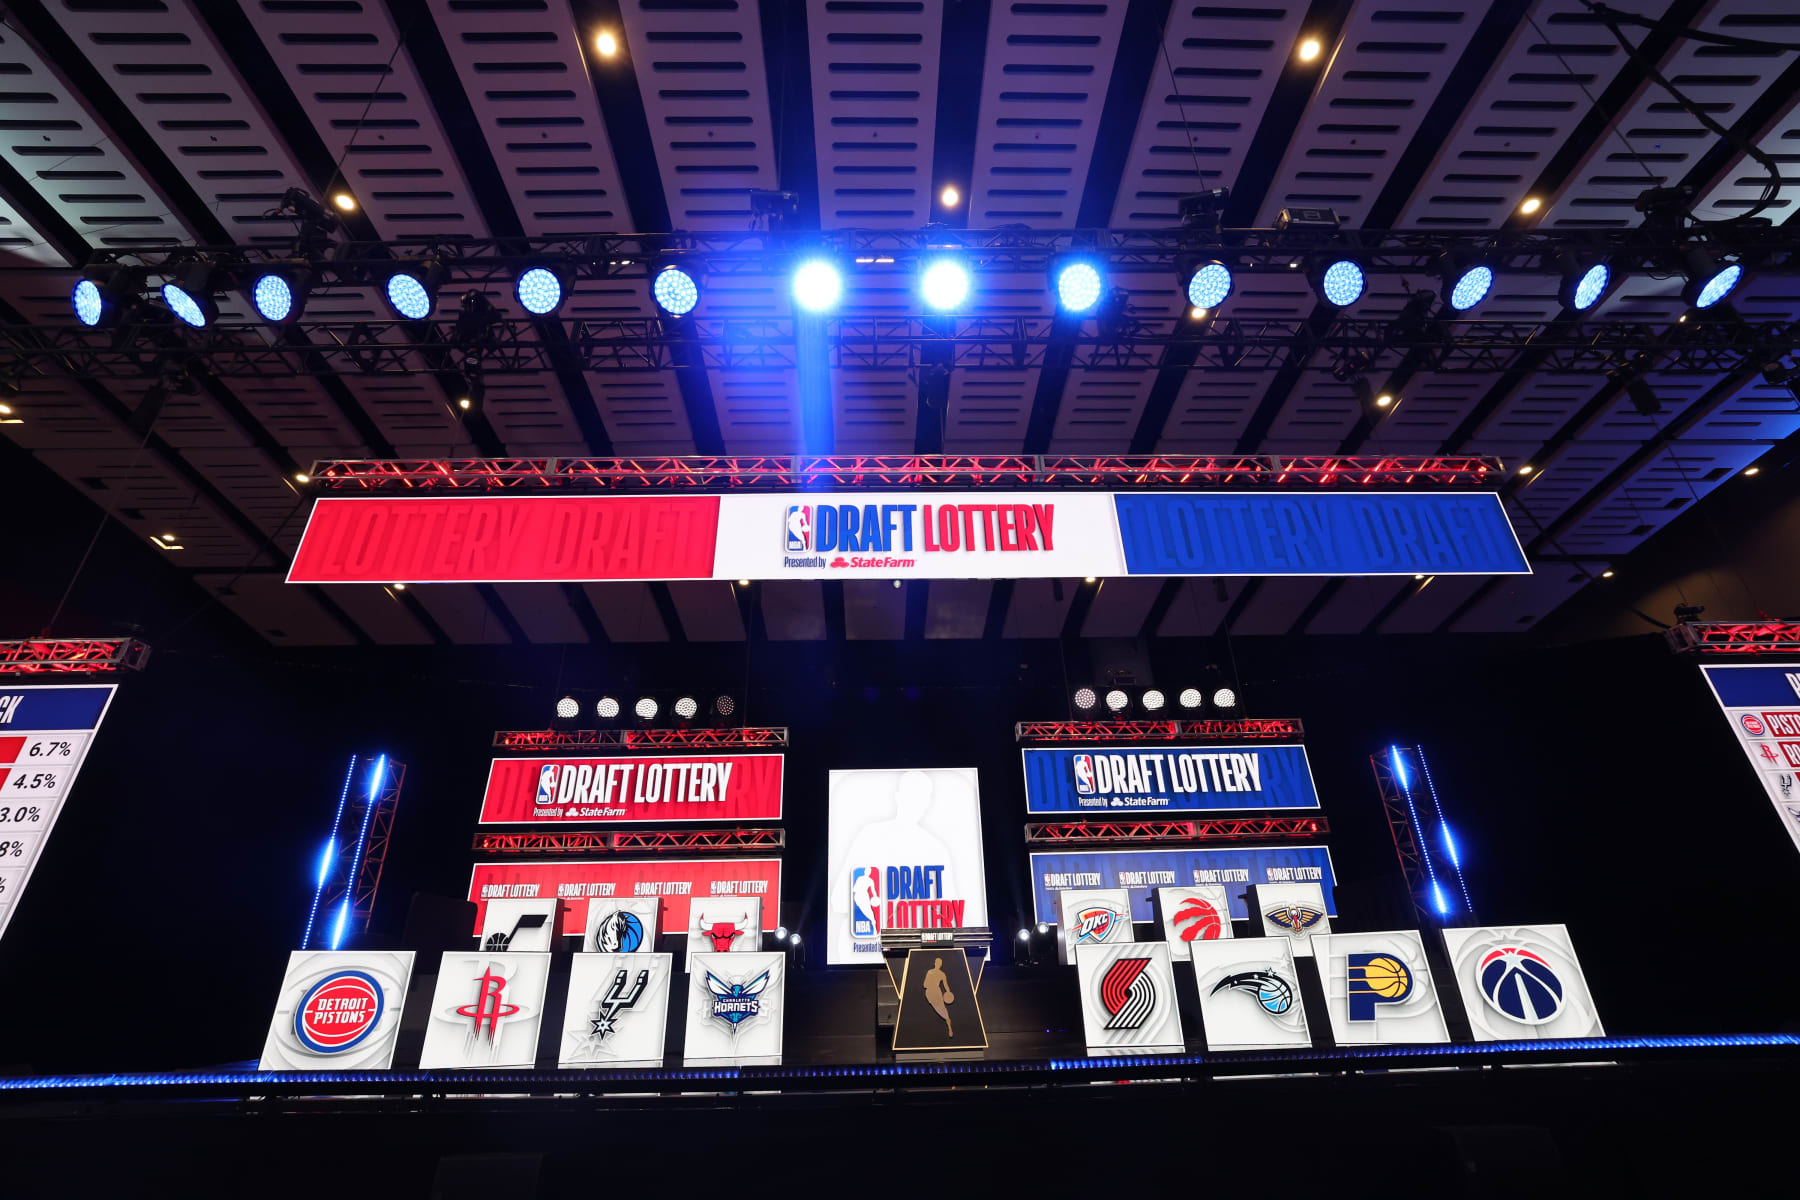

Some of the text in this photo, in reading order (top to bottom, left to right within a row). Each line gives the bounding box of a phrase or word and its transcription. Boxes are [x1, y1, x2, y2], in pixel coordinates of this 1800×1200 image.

[815, 503, 1055, 552] DRAFT LOTTERY
[1146, 499, 1507, 569] LOTTERY DRAFT
[319, 503, 697, 575] LOTTERY DRAFT
[784, 556, 817, 568] Presented
[818, 556, 826, 569] by
[29, 741, 72, 757] 6.7%
[1094, 754, 1166, 794] DRAFT
[1168, 753, 1262, 793] LOTTERY
[12, 773, 57, 789] 4.5%
[557, 764, 634, 804] DRAFT
[634, 762, 733, 803] LOTTERY
[0, 806, 41, 822] 3.0%
[1051, 873, 1101, 887] DRAFT LOTTERY
[1125, 871, 1175, 884] DRAFT LOTTERY
[1200, 868, 1249, 882] DRAFT LOTTERY
[1273, 867, 1322, 880] DRAFT LOTTERY
[640, 882, 692, 895] DRAFT LOTTERY
[717, 880, 768, 894] DRAFT LOTTERY
[887, 865, 944, 899] DRAFT
[488, 884, 540, 897] DRAFT LOTTERY
[564, 883, 616, 896] DRAFT LOTTERY
[855, 921, 871, 932] NBA
[1080, 913, 1108, 936] OKC
[853, 942, 876, 952] Presented
[317, 997, 369, 1011] DETROIT
[714, 1000, 759, 1014] HORNETS
[313, 1010, 366, 1025] PISTONS
